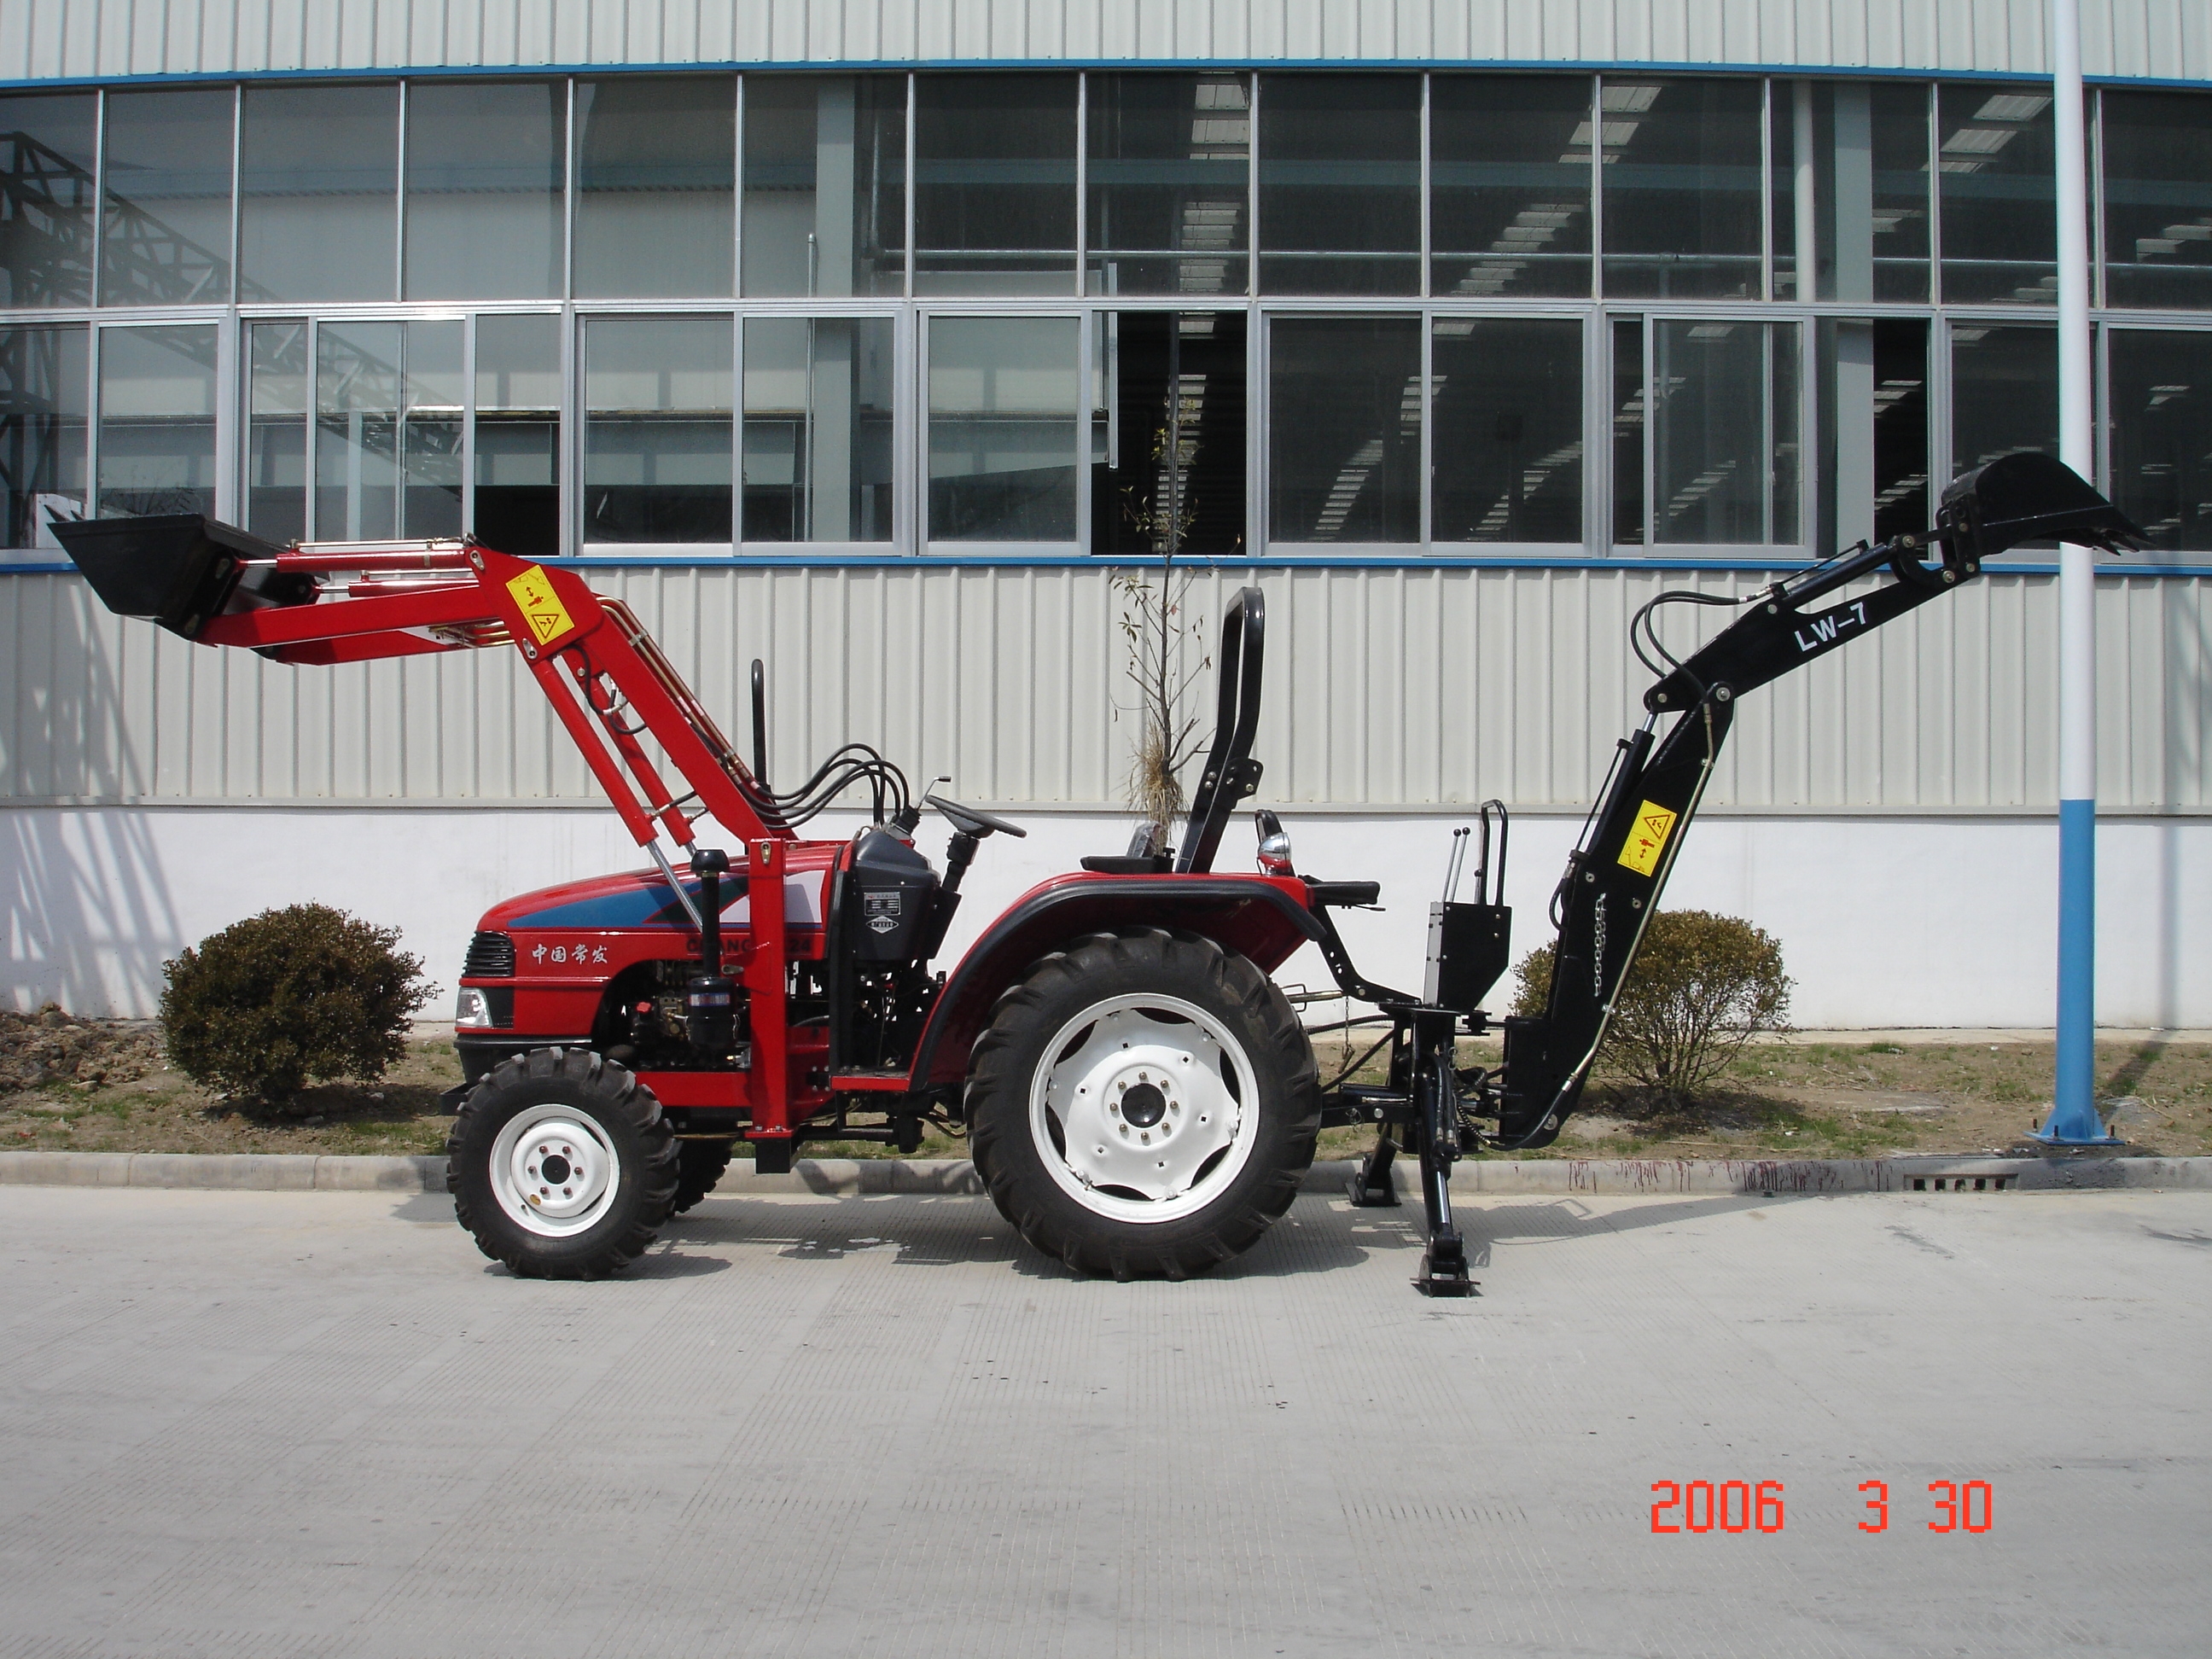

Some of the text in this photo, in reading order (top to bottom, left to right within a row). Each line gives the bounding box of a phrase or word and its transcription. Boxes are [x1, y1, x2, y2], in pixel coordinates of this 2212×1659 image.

[1795, 602, 1866, 652] LW-7
[532, 943, 608, 965] 中国常发
